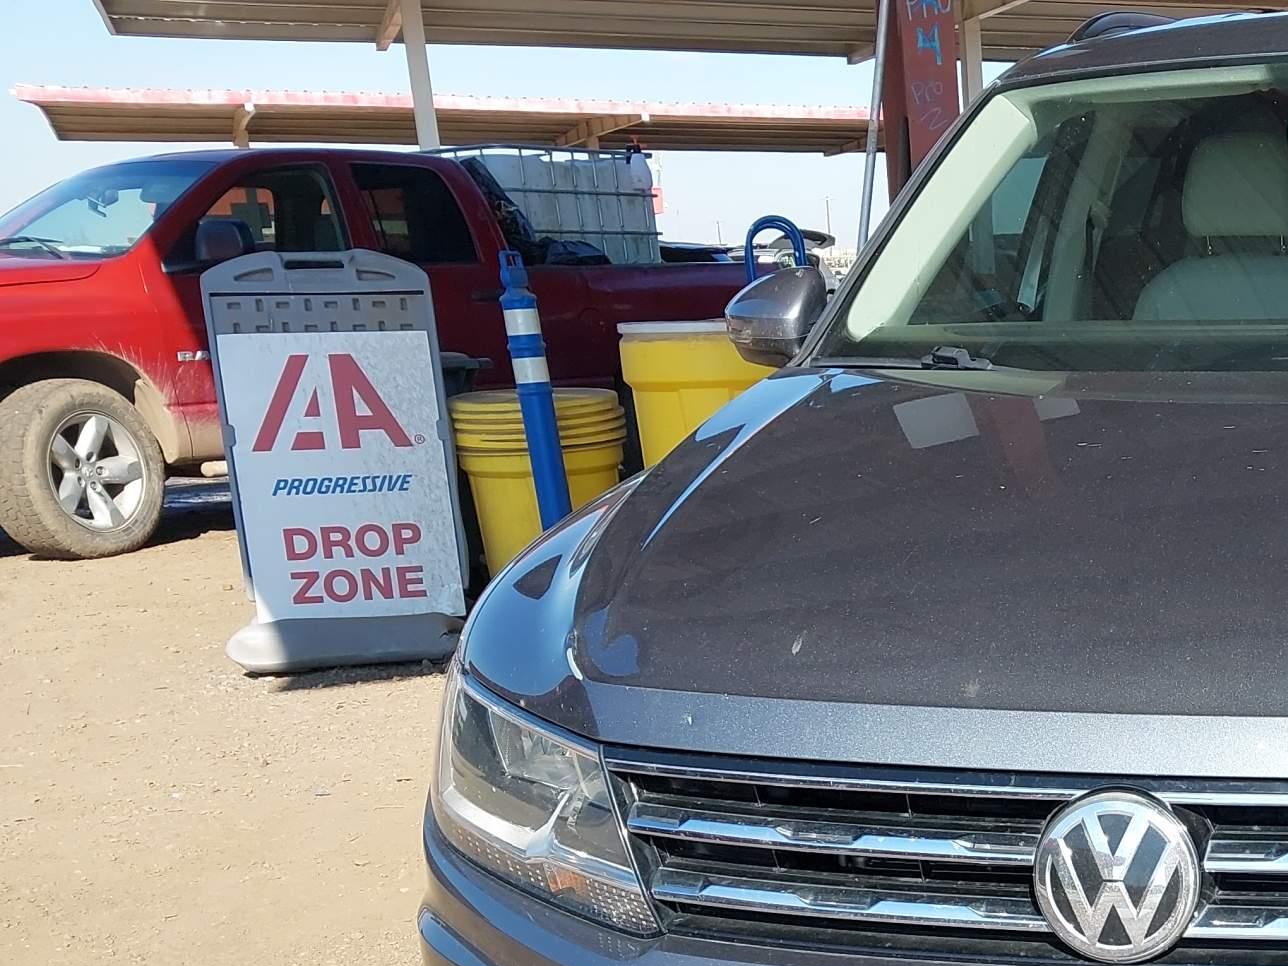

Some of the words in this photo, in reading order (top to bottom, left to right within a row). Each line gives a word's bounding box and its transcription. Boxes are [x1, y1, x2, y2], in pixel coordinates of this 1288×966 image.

[272, 474, 413, 497] PROGRESSIVE
[282, 522, 422, 561] DROP
[290, 565, 428, 605] ZONE
